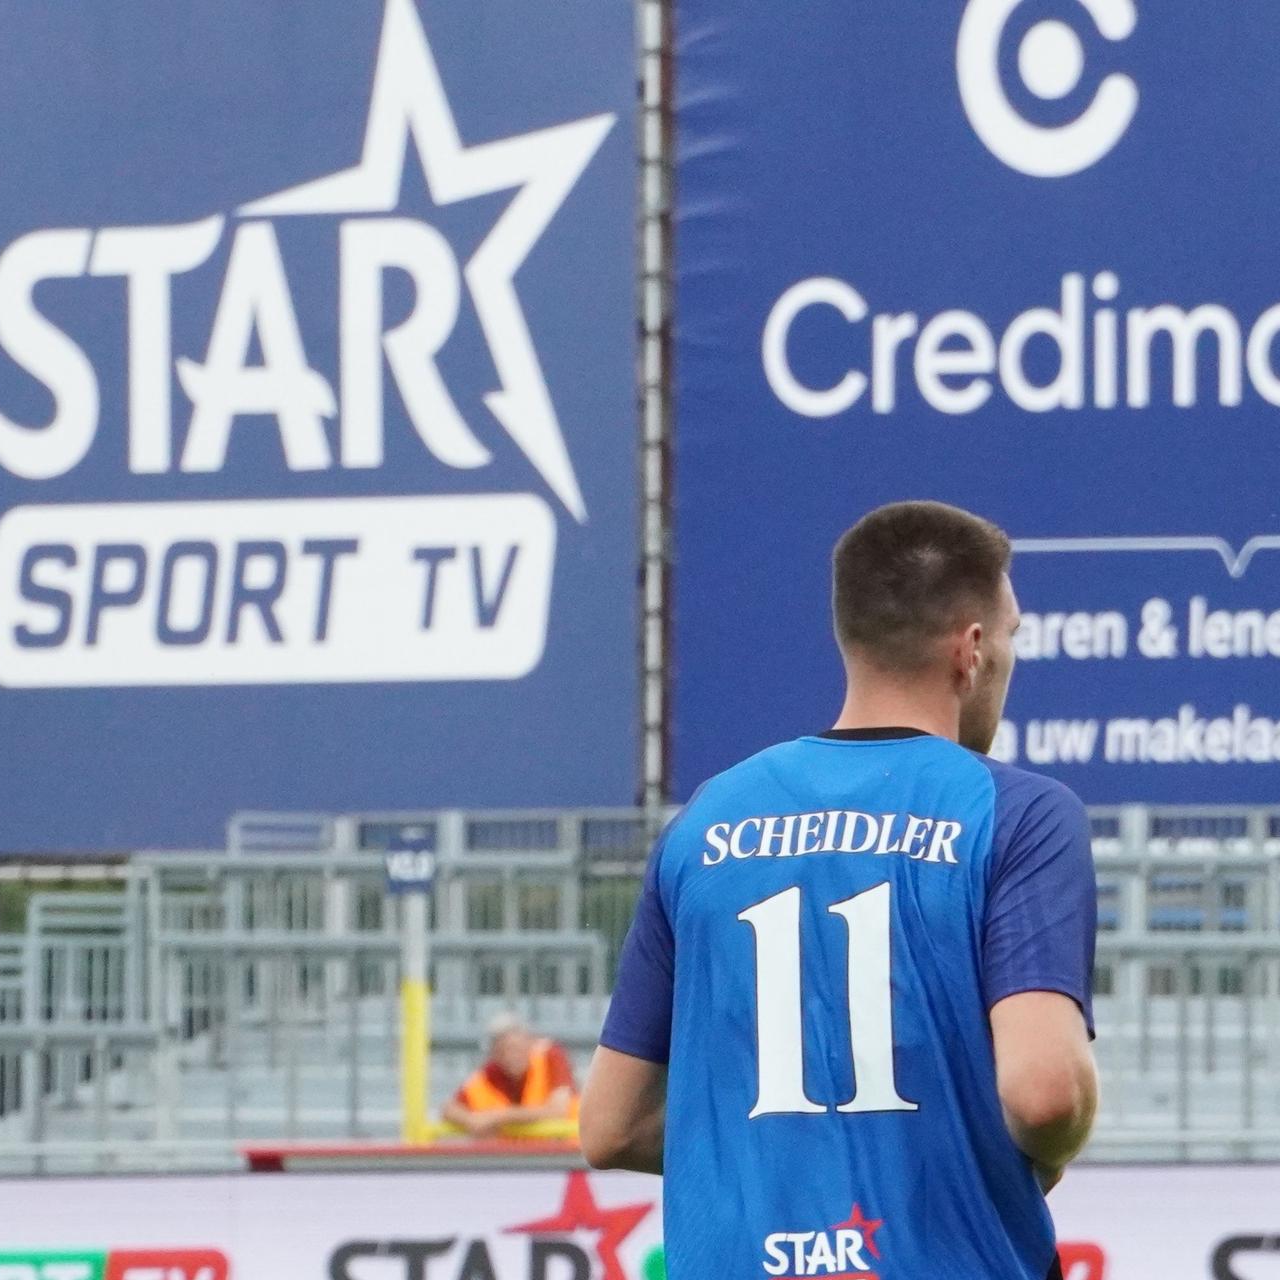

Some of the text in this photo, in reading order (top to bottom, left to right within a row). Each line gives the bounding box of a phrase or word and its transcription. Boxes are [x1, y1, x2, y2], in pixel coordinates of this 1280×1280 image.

[13, 538, 519, 649] SPORT TV
[1016, 611, 1128, 660] aren
[1137, 597, 1179, 659] &
[1026, 718, 1098, 764] uw
[702, 811, 962, 866] SCHEIDLER
[737, 881, 919, 1119] 11
[762, 1229, 871, 1275] STAR
